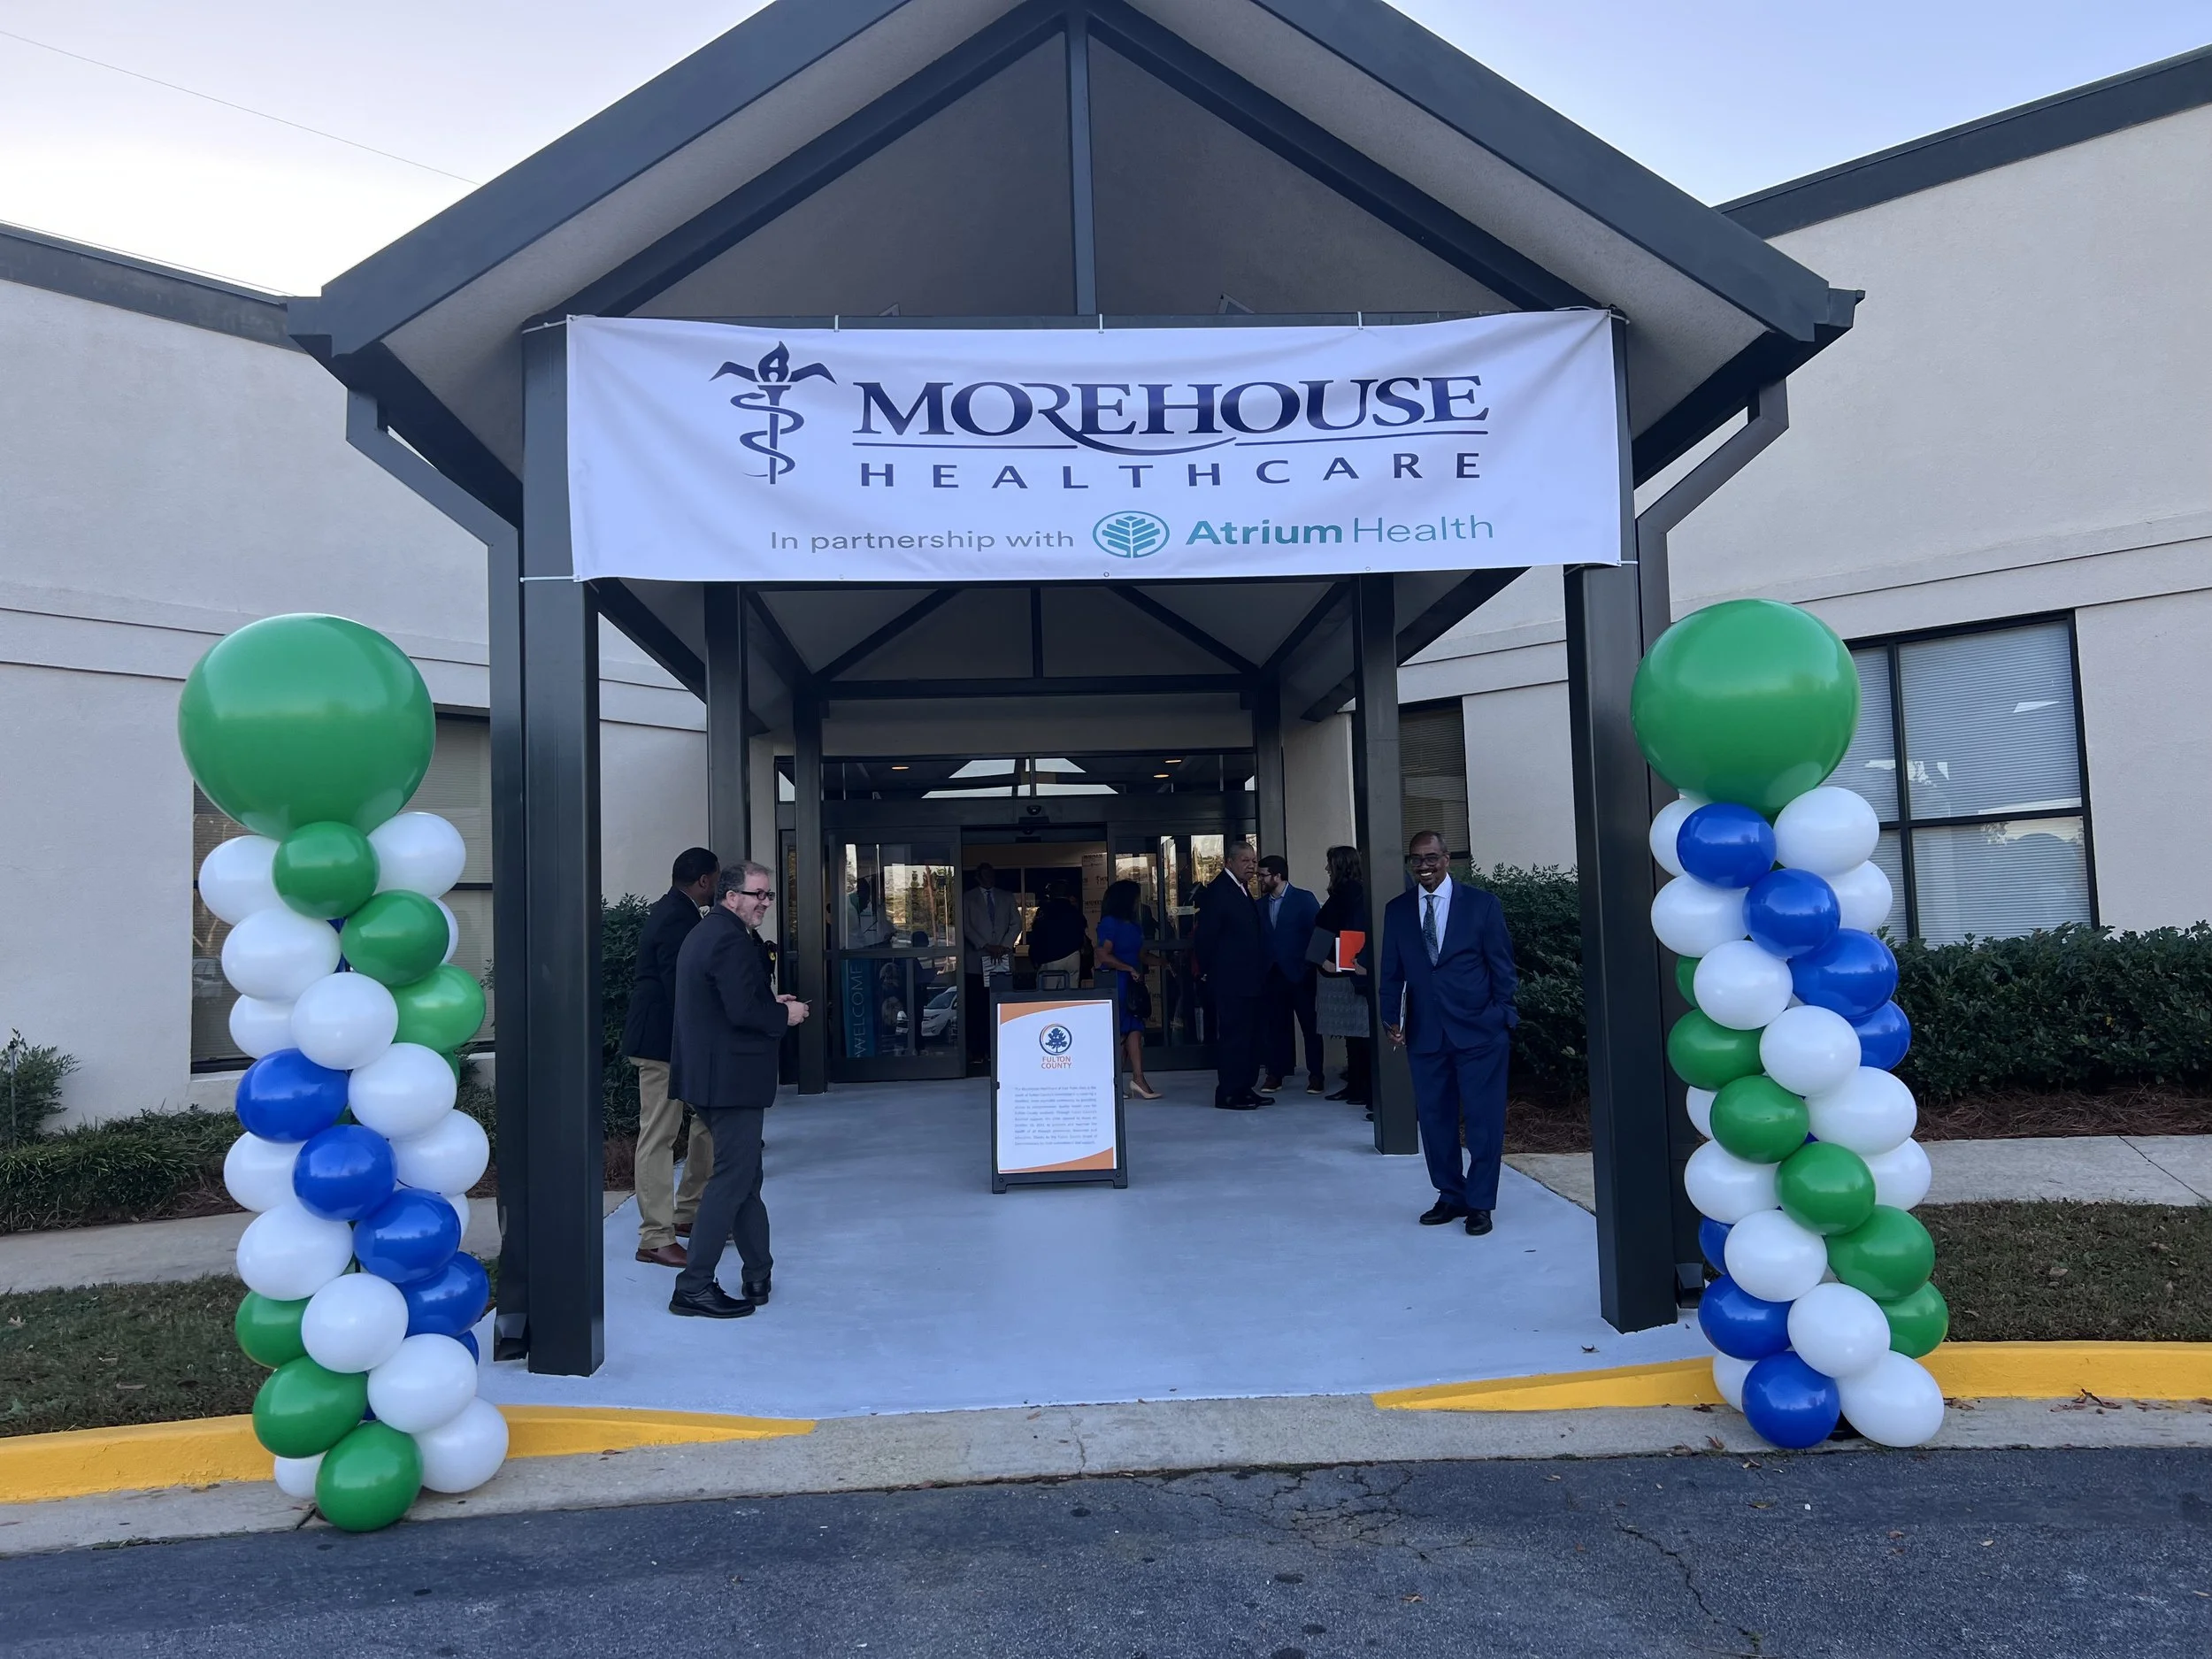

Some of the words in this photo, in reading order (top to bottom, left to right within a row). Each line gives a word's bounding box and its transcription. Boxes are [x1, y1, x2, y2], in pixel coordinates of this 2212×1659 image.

[853, 375, 1490, 455] MOREHOUSE
[860, 453, 1481, 489] HEALTHCARE
[770, 531, 799, 551] In
[810, 529, 995, 555] partnership
[1005, 530, 1074, 549] with
[1186, 519, 1343, 546] Atrium
[1354, 514, 1494, 543] Health
[849, 961, 868, 1059] WELCOME
